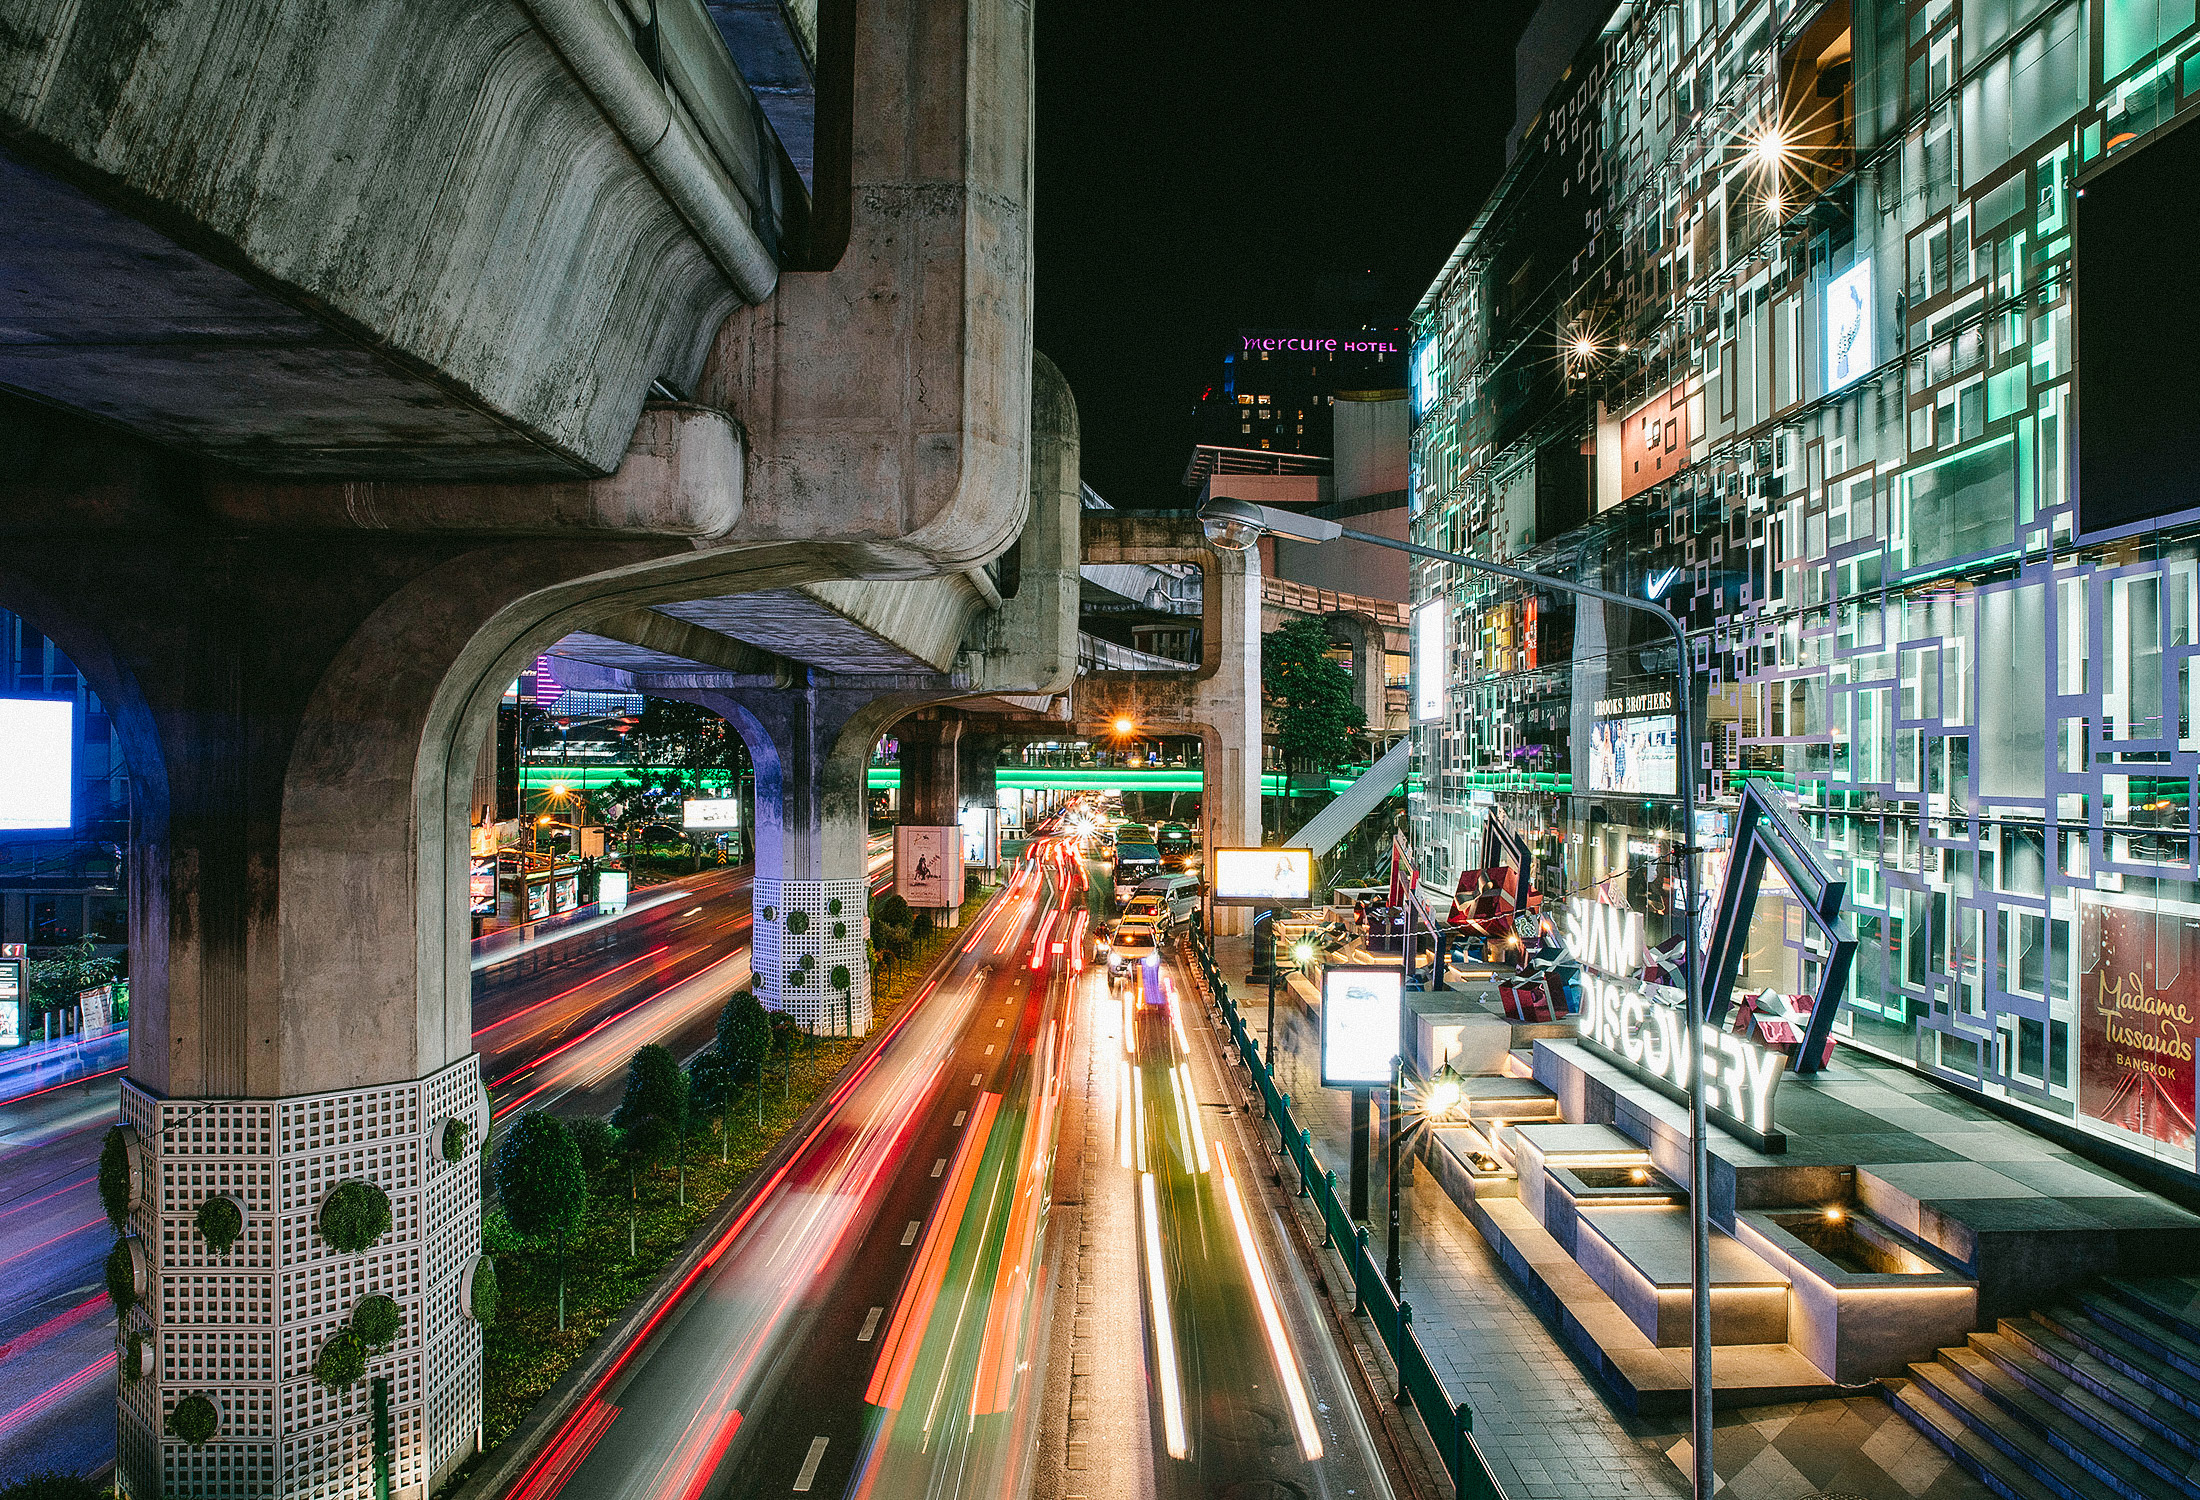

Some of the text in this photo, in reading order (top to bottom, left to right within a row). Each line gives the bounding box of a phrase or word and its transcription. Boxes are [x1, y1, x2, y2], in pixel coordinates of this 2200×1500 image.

[1242, 335, 1398, 353] mercure HOTEL
[1593, 697, 1624, 716] BROOKS
[1625, 691, 1672, 713] BROTHERS
[1566, 897, 1641, 977] SIAM
[2097, 969, 2194, 1024] Madame
[2096, 1007, 2192, 1062] Tussauds
[2116, 1053, 2176, 1080] BANGKOK
